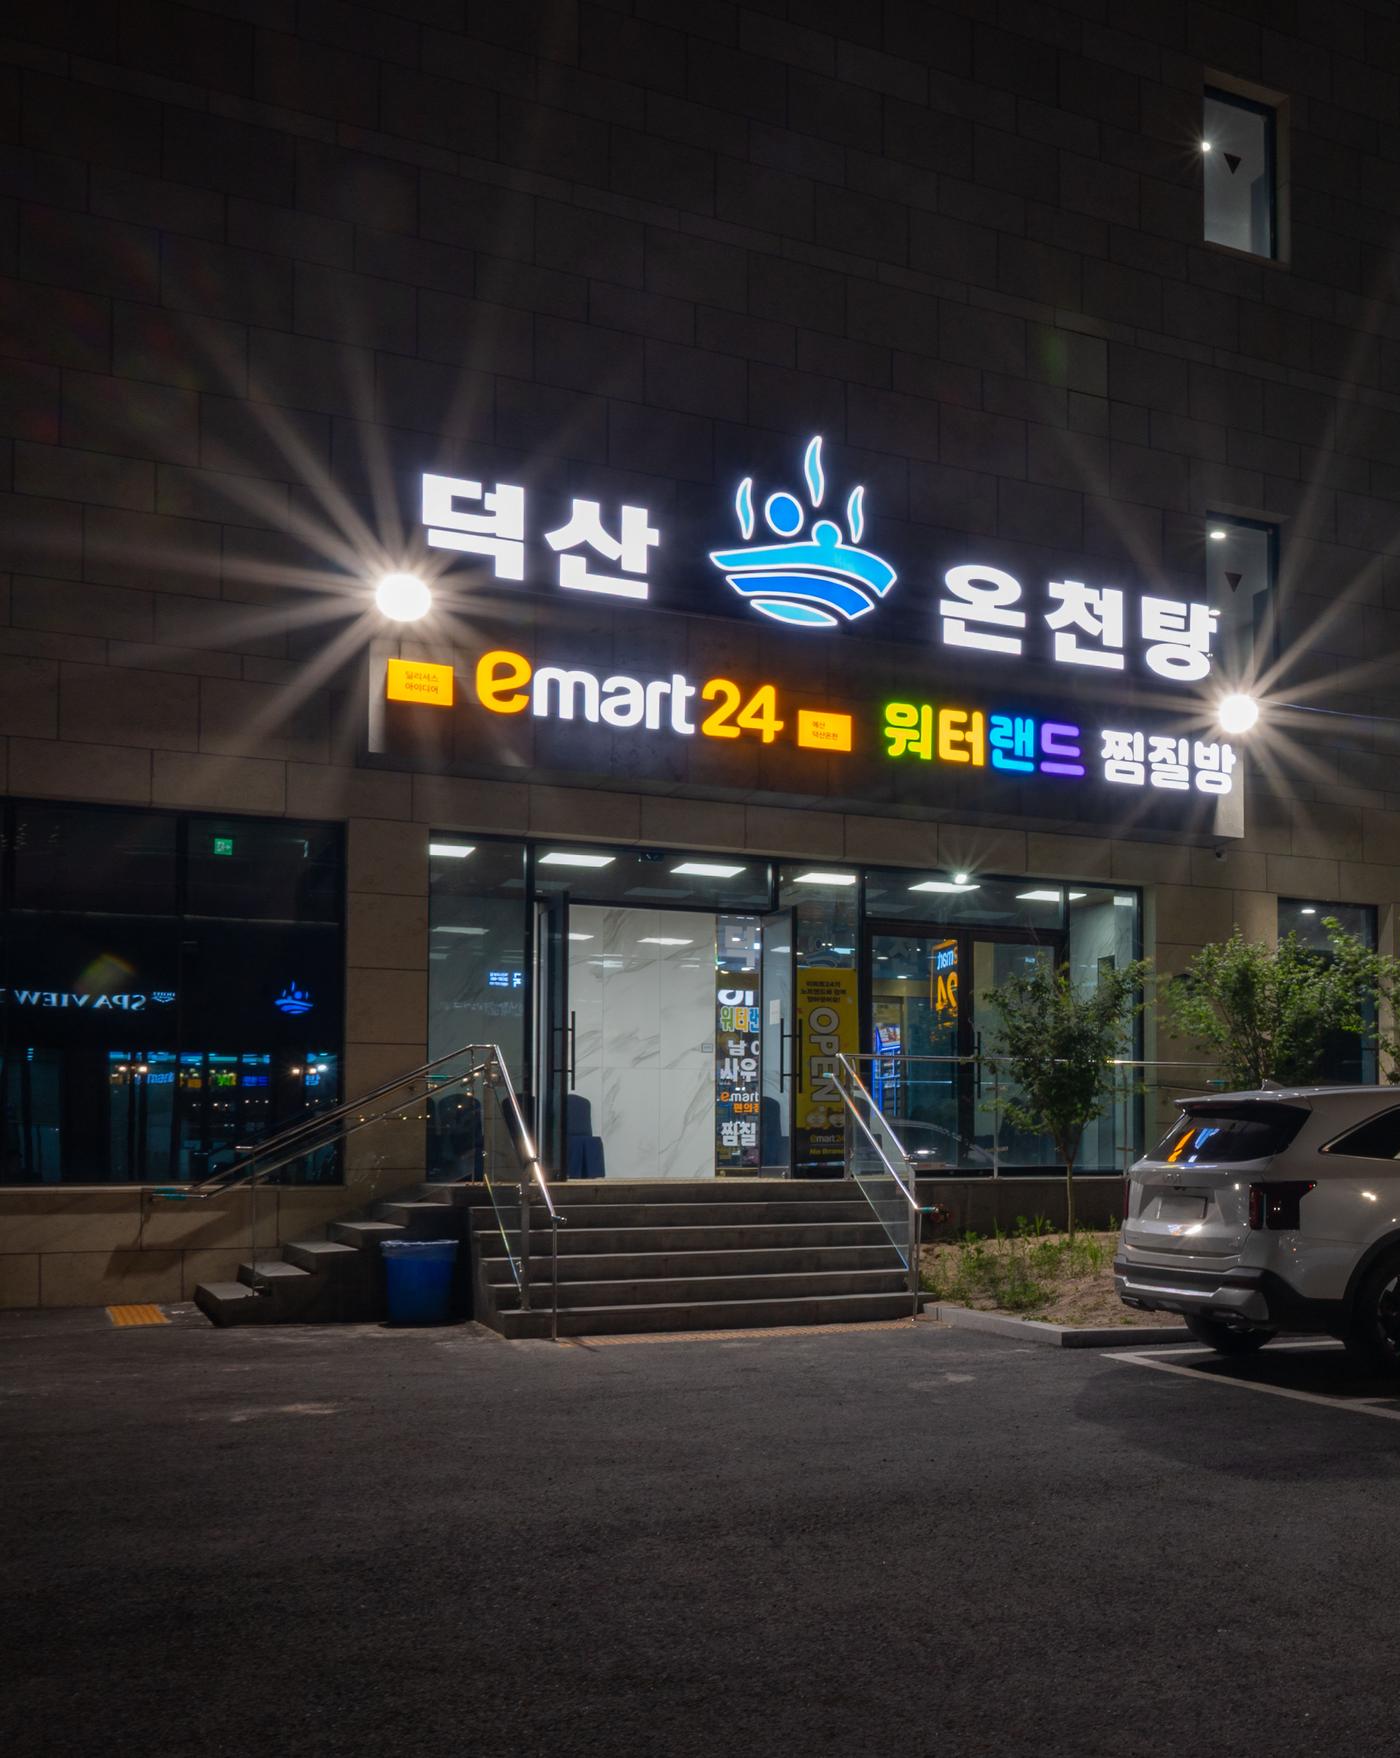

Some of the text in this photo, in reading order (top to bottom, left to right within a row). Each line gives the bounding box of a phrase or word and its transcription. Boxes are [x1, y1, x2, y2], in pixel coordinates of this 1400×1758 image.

[422, 473, 1218, 681] 덕산 온천탕
[884, 702, 1236, 794] 워터랜드 찜질방
[808, 1006, 842, 1102] OPEN
